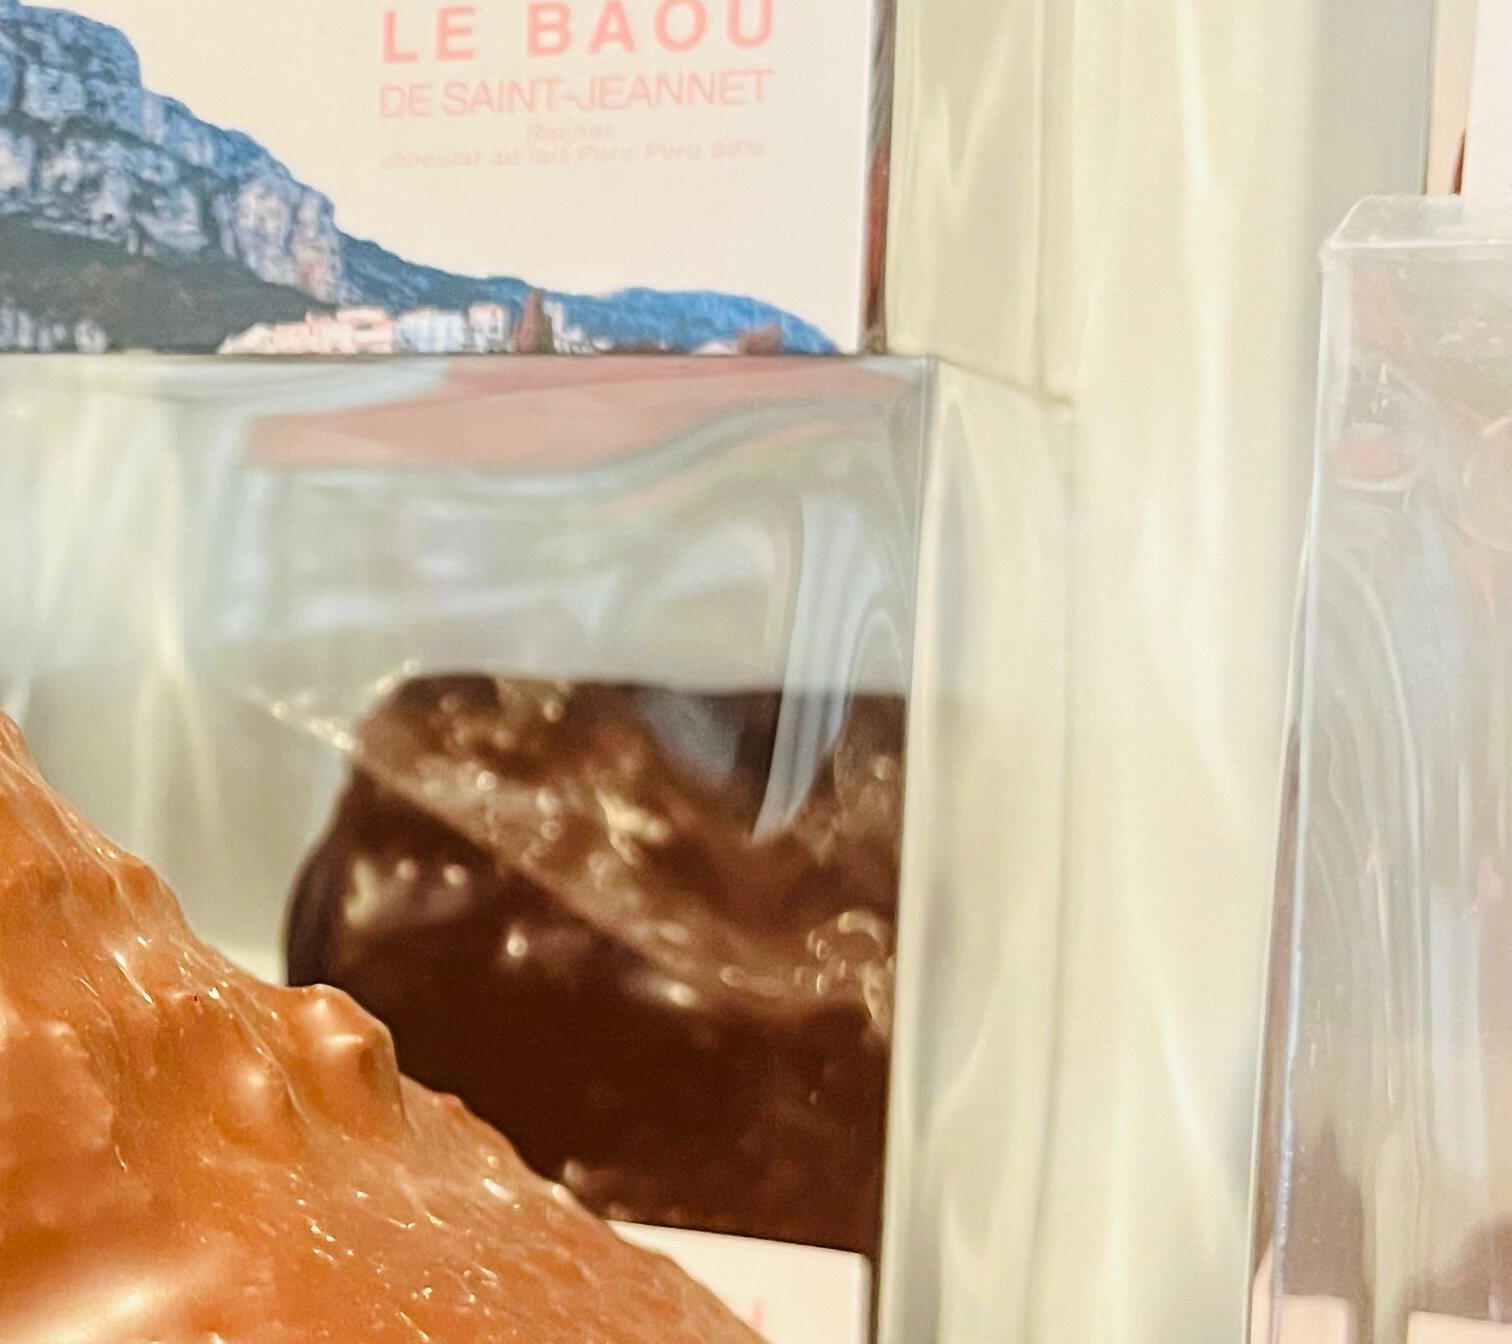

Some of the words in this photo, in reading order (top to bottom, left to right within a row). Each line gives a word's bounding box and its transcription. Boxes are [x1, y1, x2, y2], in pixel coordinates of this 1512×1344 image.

[383, 5, 477, 64] LE
[379, 83, 433, 119] DE
[442, 68, 775, 117] SAINT-JEANNET
